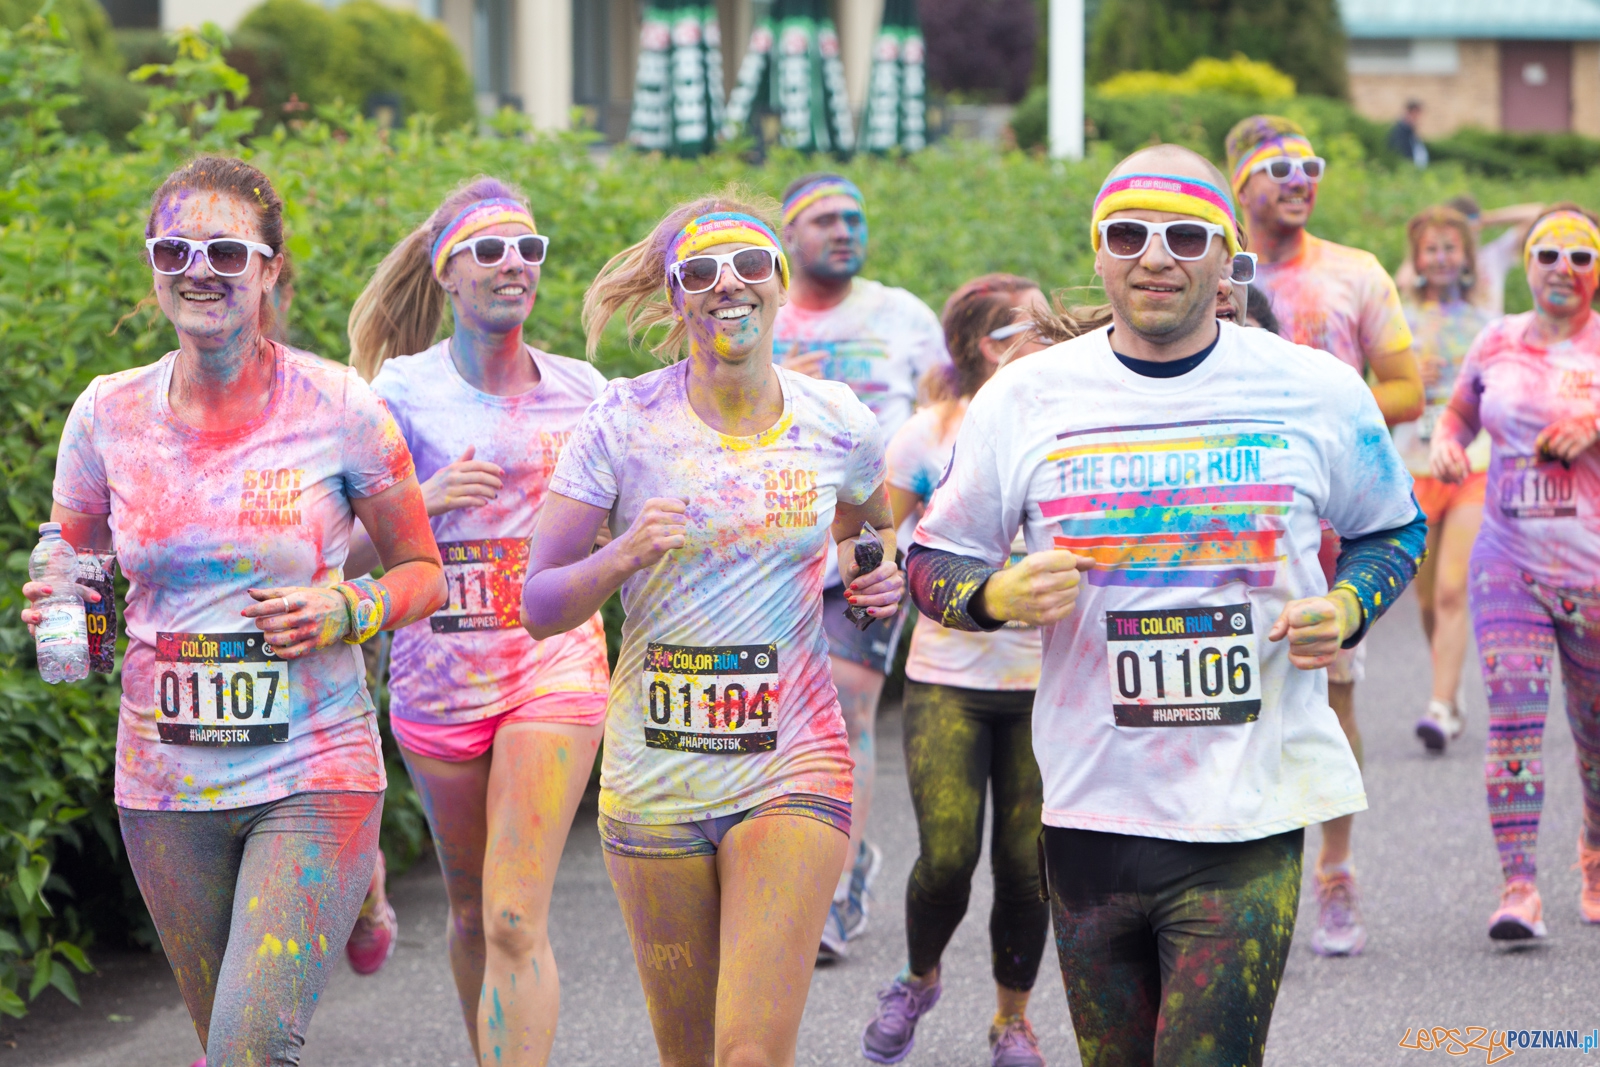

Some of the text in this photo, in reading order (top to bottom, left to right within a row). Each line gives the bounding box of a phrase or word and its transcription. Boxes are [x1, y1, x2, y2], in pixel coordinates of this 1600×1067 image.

[1129, 179, 1182, 192] COLOR RUNNER
[242, 468, 305, 490] BOOT
[764, 469, 818, 490] BOOT
[1057, 456, 1104, 493] THE
[1110, 452, 1201, 489] COLOR
[240, 490, 302, 510] CAMP
[238, 510, 302, 526] POZNAN
[765, 511, 818, 528] POZNAN
[1115, 618, 1140, 635] THE
[1140, 616, 1185, 635] COLOR
[181, 640, 218, 658] COLOR
[673, 653, 713, 670] COLOR
[1116, 645, 1252, 699] 01106
[160, 670, 280, 720] 01107
[649, 680, 772, 729] 01104
[1153, 706, 1221, 722] #HAPPIEST5K
[189, 729, 250, 742] #HAPPIEST5K
[680, 735, 741, 750] #HAPPIEST5K
